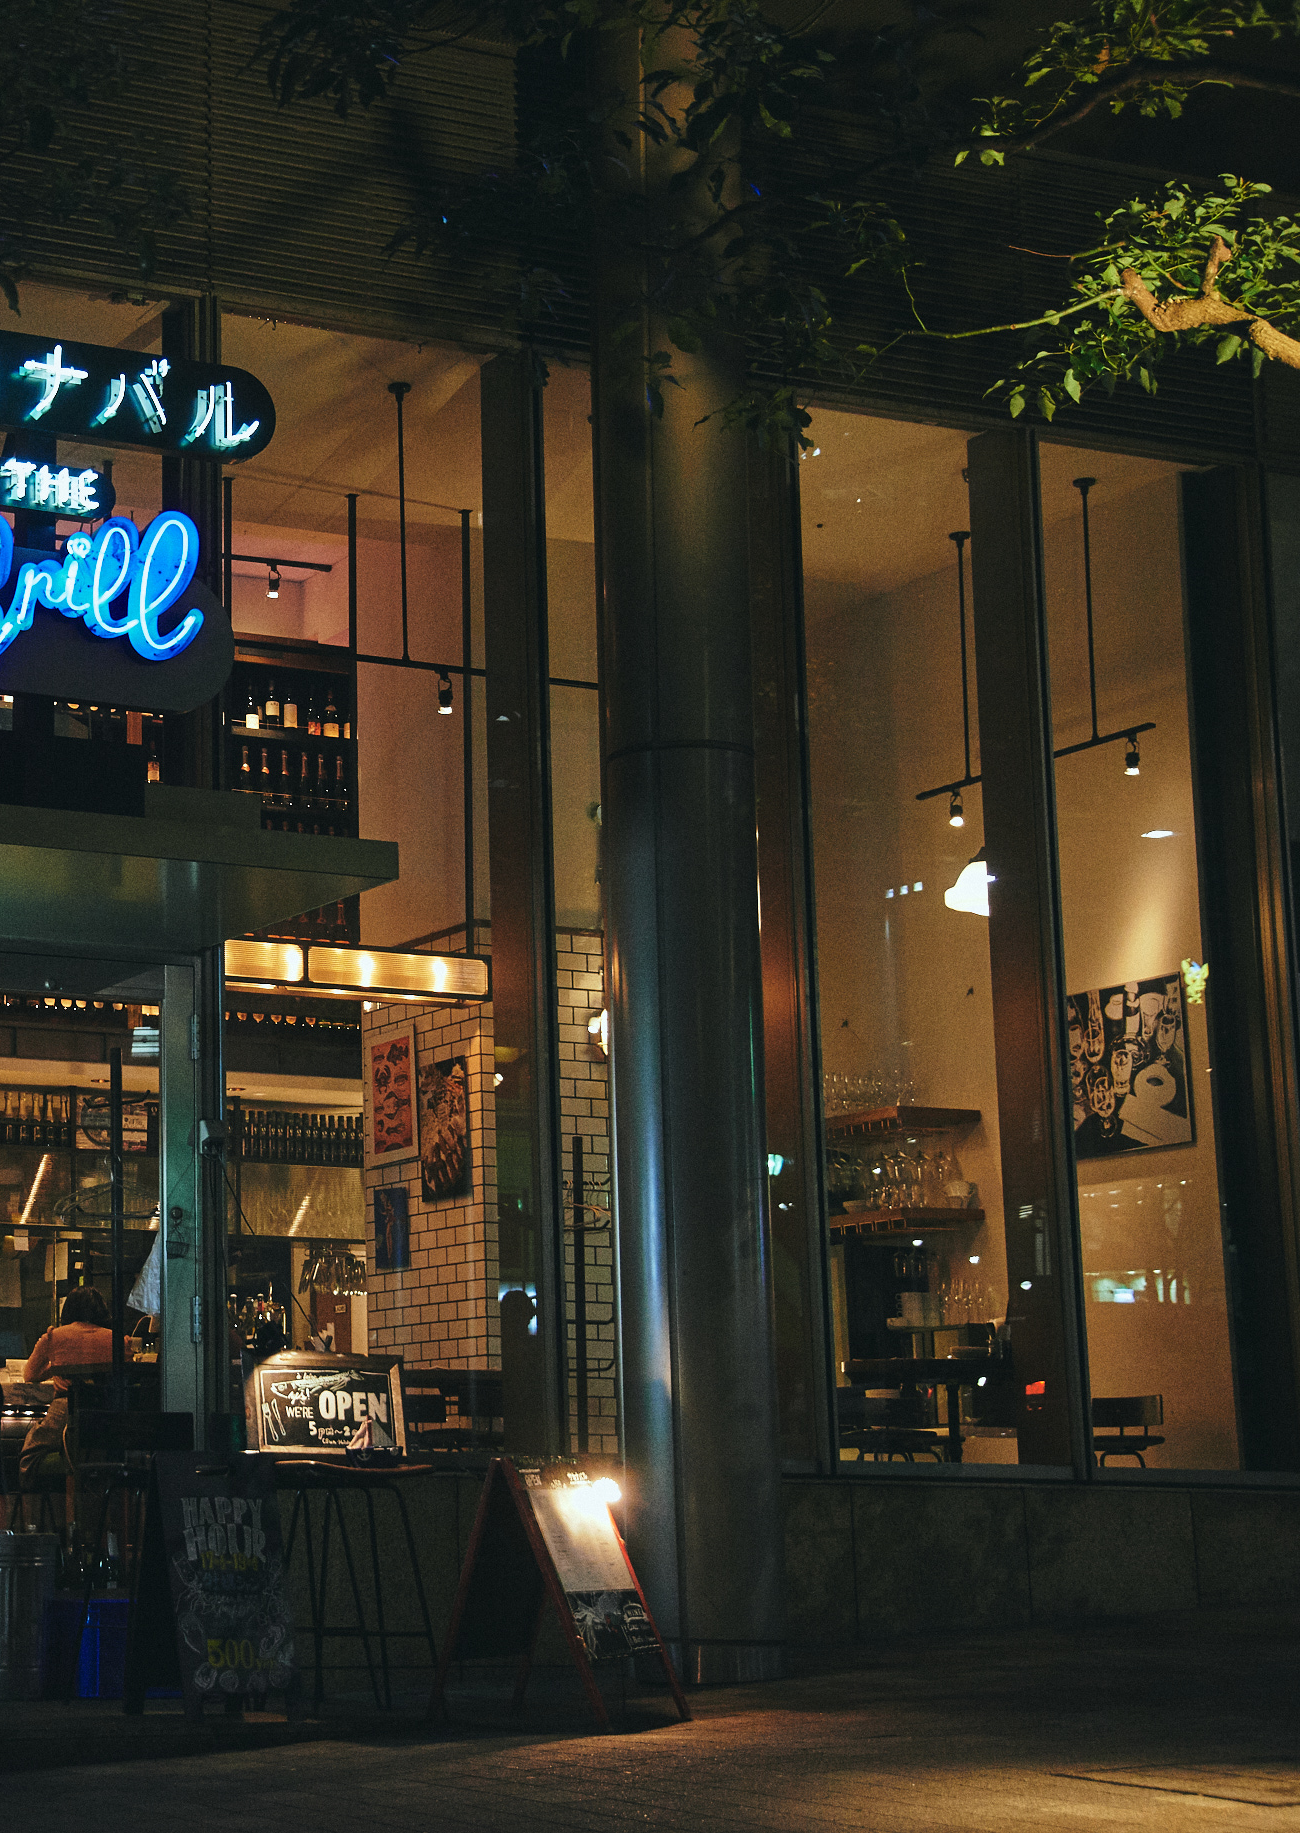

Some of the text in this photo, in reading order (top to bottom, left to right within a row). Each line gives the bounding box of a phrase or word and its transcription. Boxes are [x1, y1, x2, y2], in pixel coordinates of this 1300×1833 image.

[318, 1390, 388, 1423] OPEN
[180, 1495, 263, 1530] HAPPY
[182, 1522, 267, 1564] HOUR
